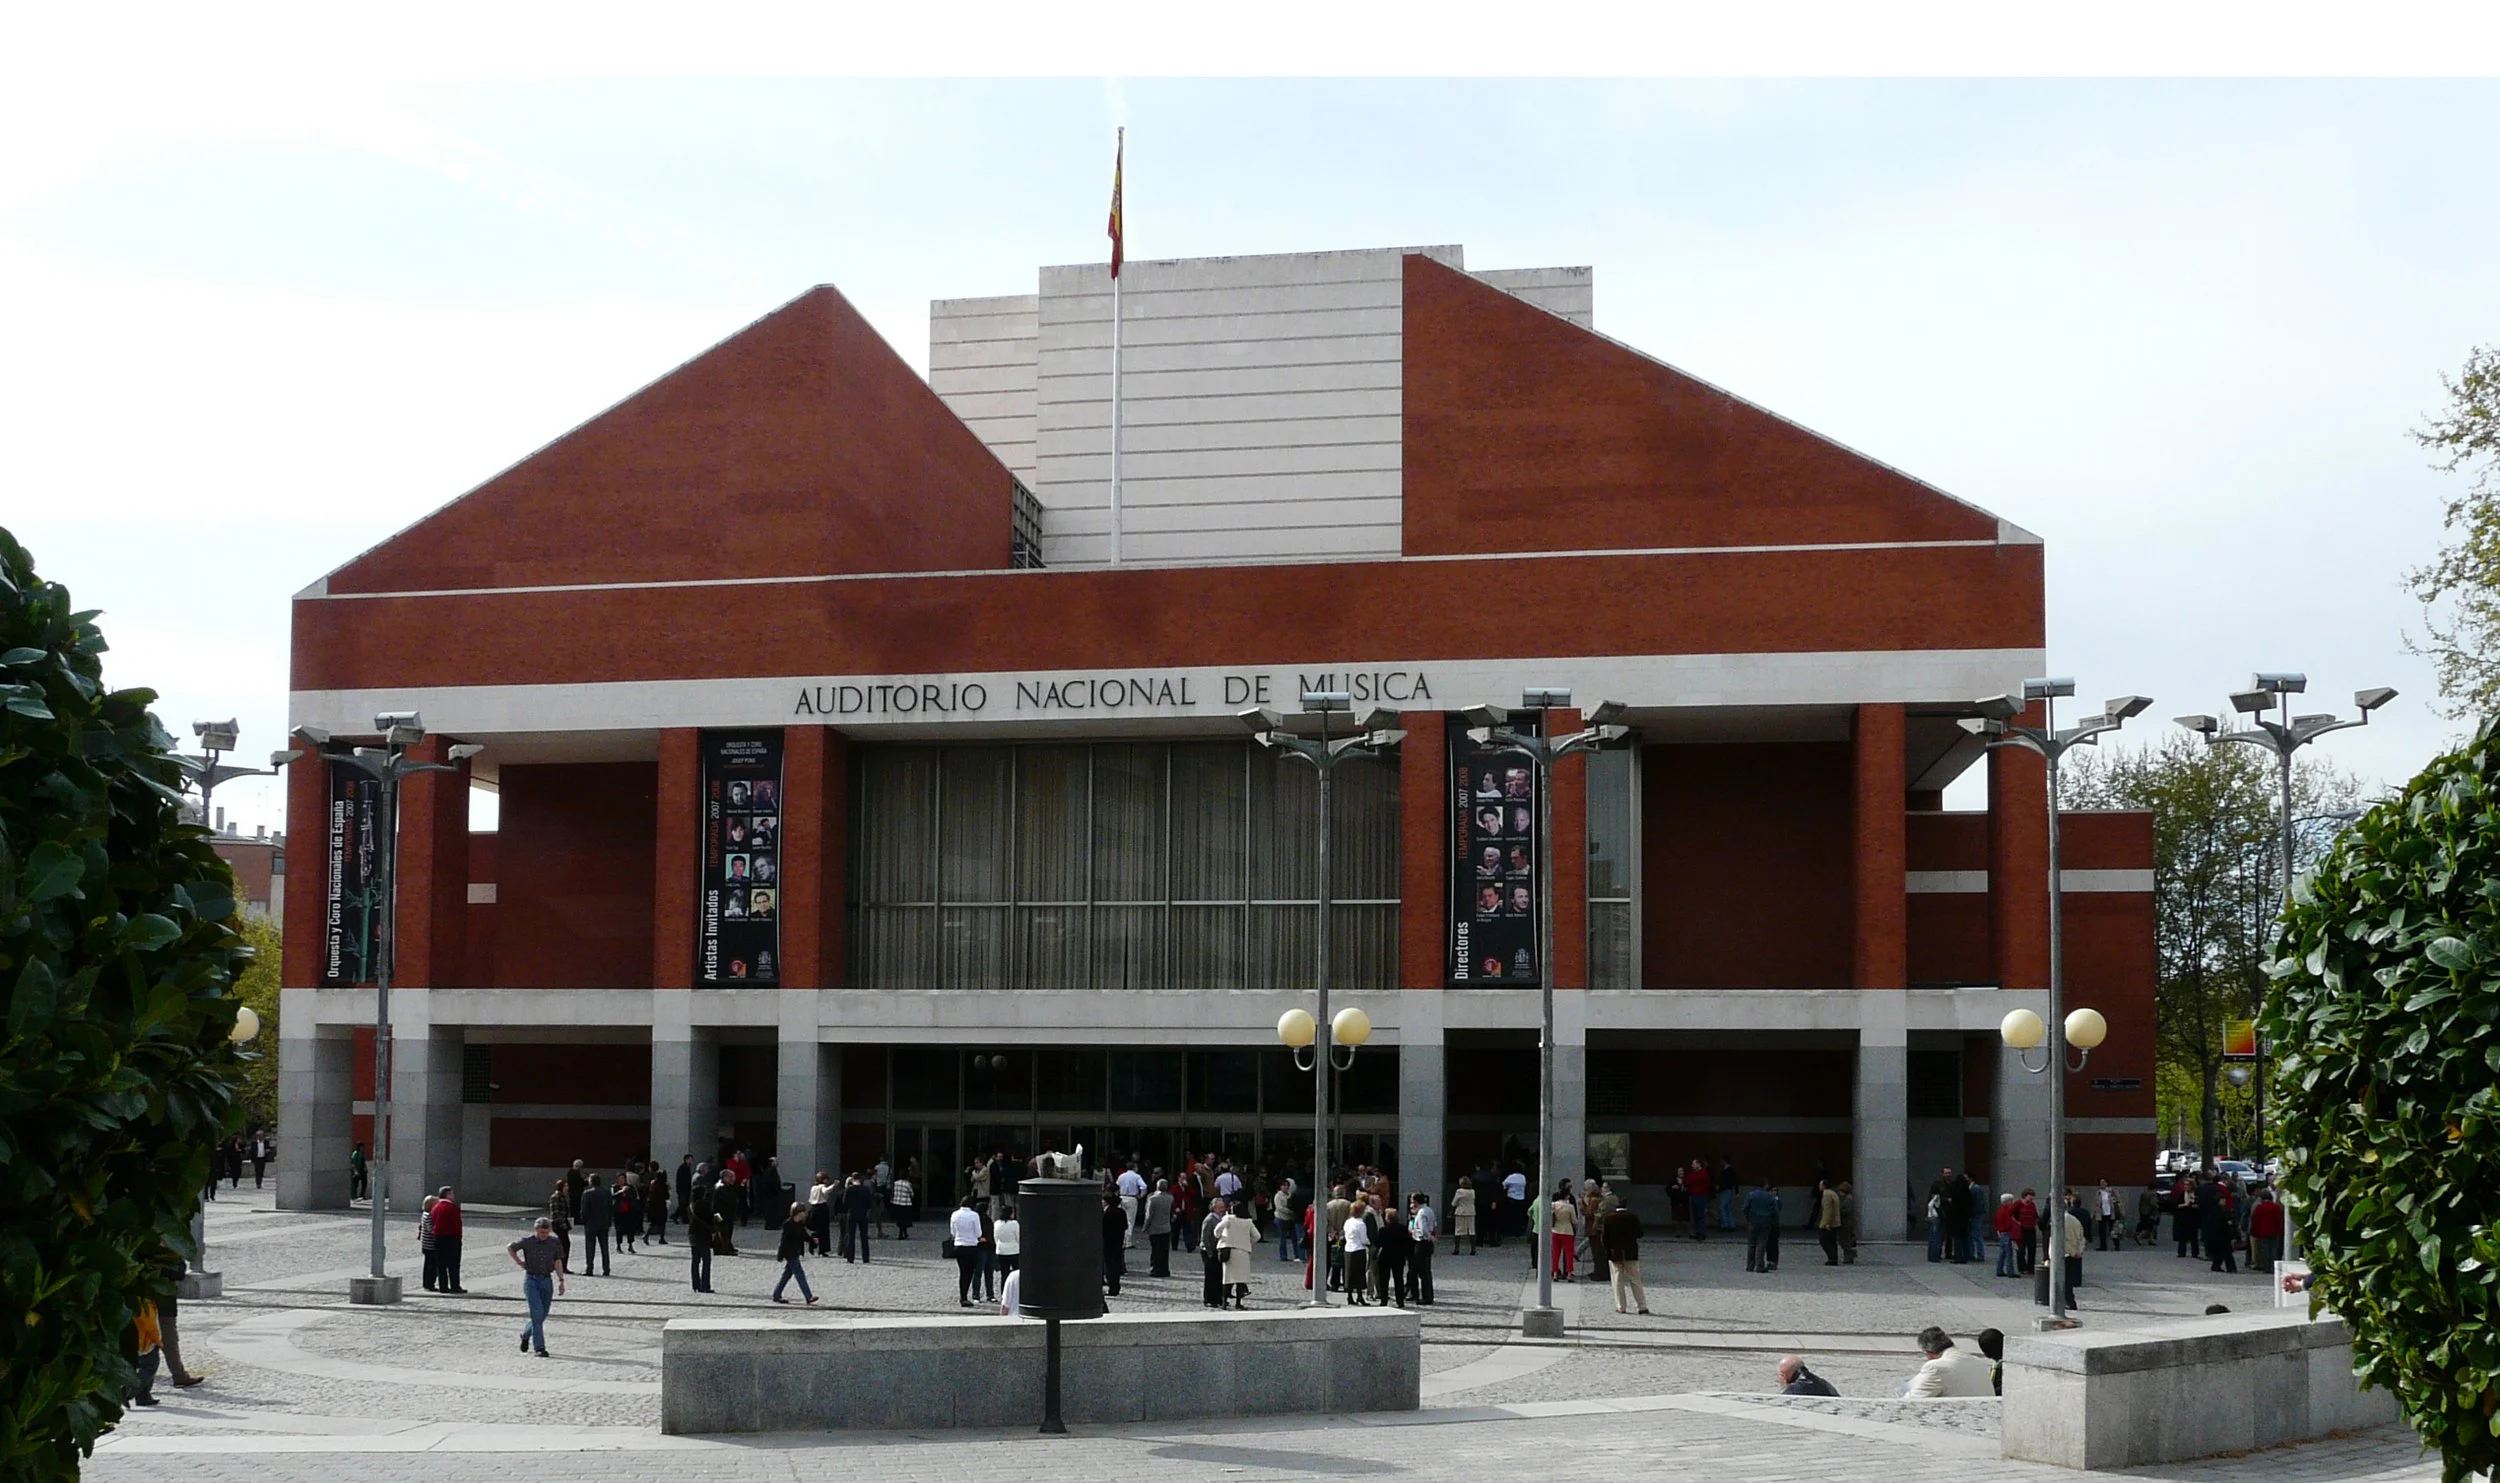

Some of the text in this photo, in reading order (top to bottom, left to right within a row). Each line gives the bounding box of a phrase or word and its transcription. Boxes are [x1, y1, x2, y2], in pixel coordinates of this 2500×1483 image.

[795, 671, 1432, 715] AUDITORIO NACIONAL DE MUSICA
[332, 801, 345, 833] España
[346, 800, 354, 817] 2007
[710, 801, 719, 819] 2007
[1458, 789, 1469, 808] 2007
[332, 836, 343, 847] de
[709, 820, 719, 868] TEMPORADA
[1458, 810, 1468, 859] TEMPORADA
[331, 850, 343, 900] Nacionales
[330, 903, 342, 925] Coro
[704, 890, 719, 980] Artistas Invitados
[327, 935, 340, 977] Orquesta
[1454, 922, 1469, 979] Directores
